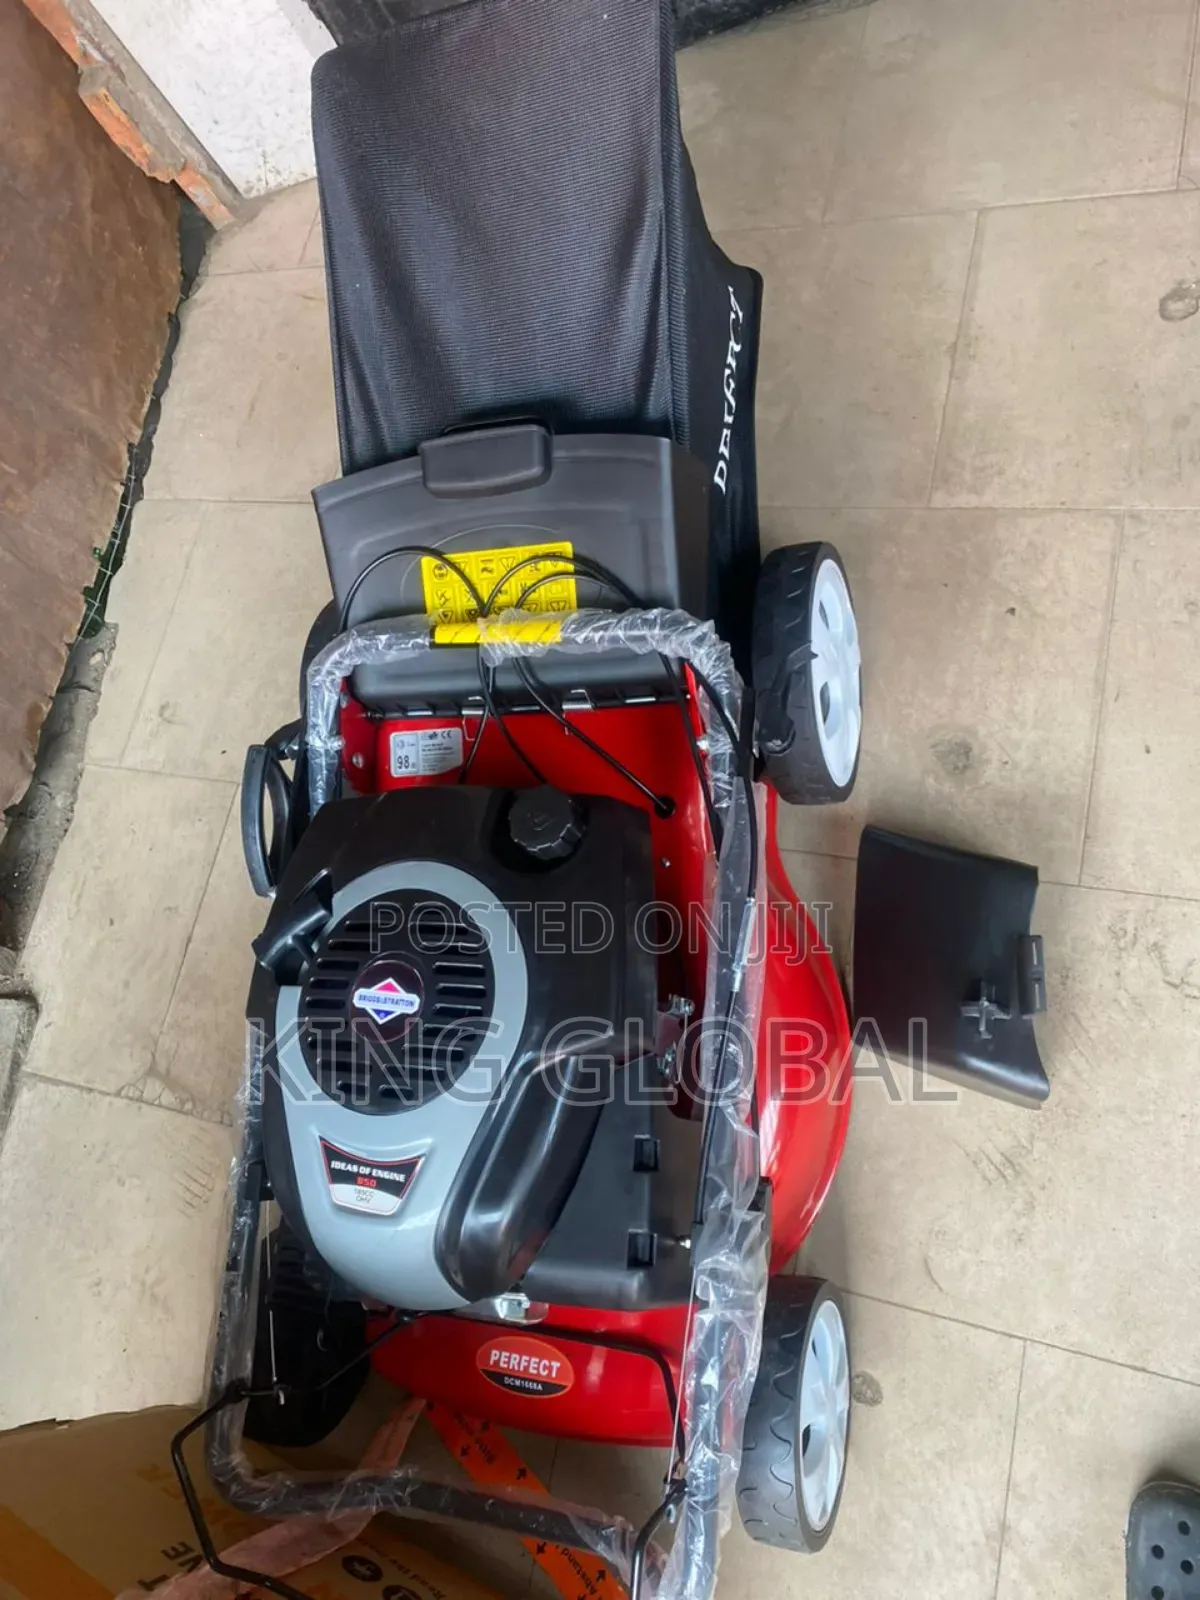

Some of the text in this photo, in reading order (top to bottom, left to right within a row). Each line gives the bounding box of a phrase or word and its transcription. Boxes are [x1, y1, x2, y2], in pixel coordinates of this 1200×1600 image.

[396, 755, 410, 769] 98
[330, 1160, 406, 1182] IDEAS OF ENGINE
[489, 1349, 561, 1379] PERFECT
[560, 1548, 598, 1595] Abstand
